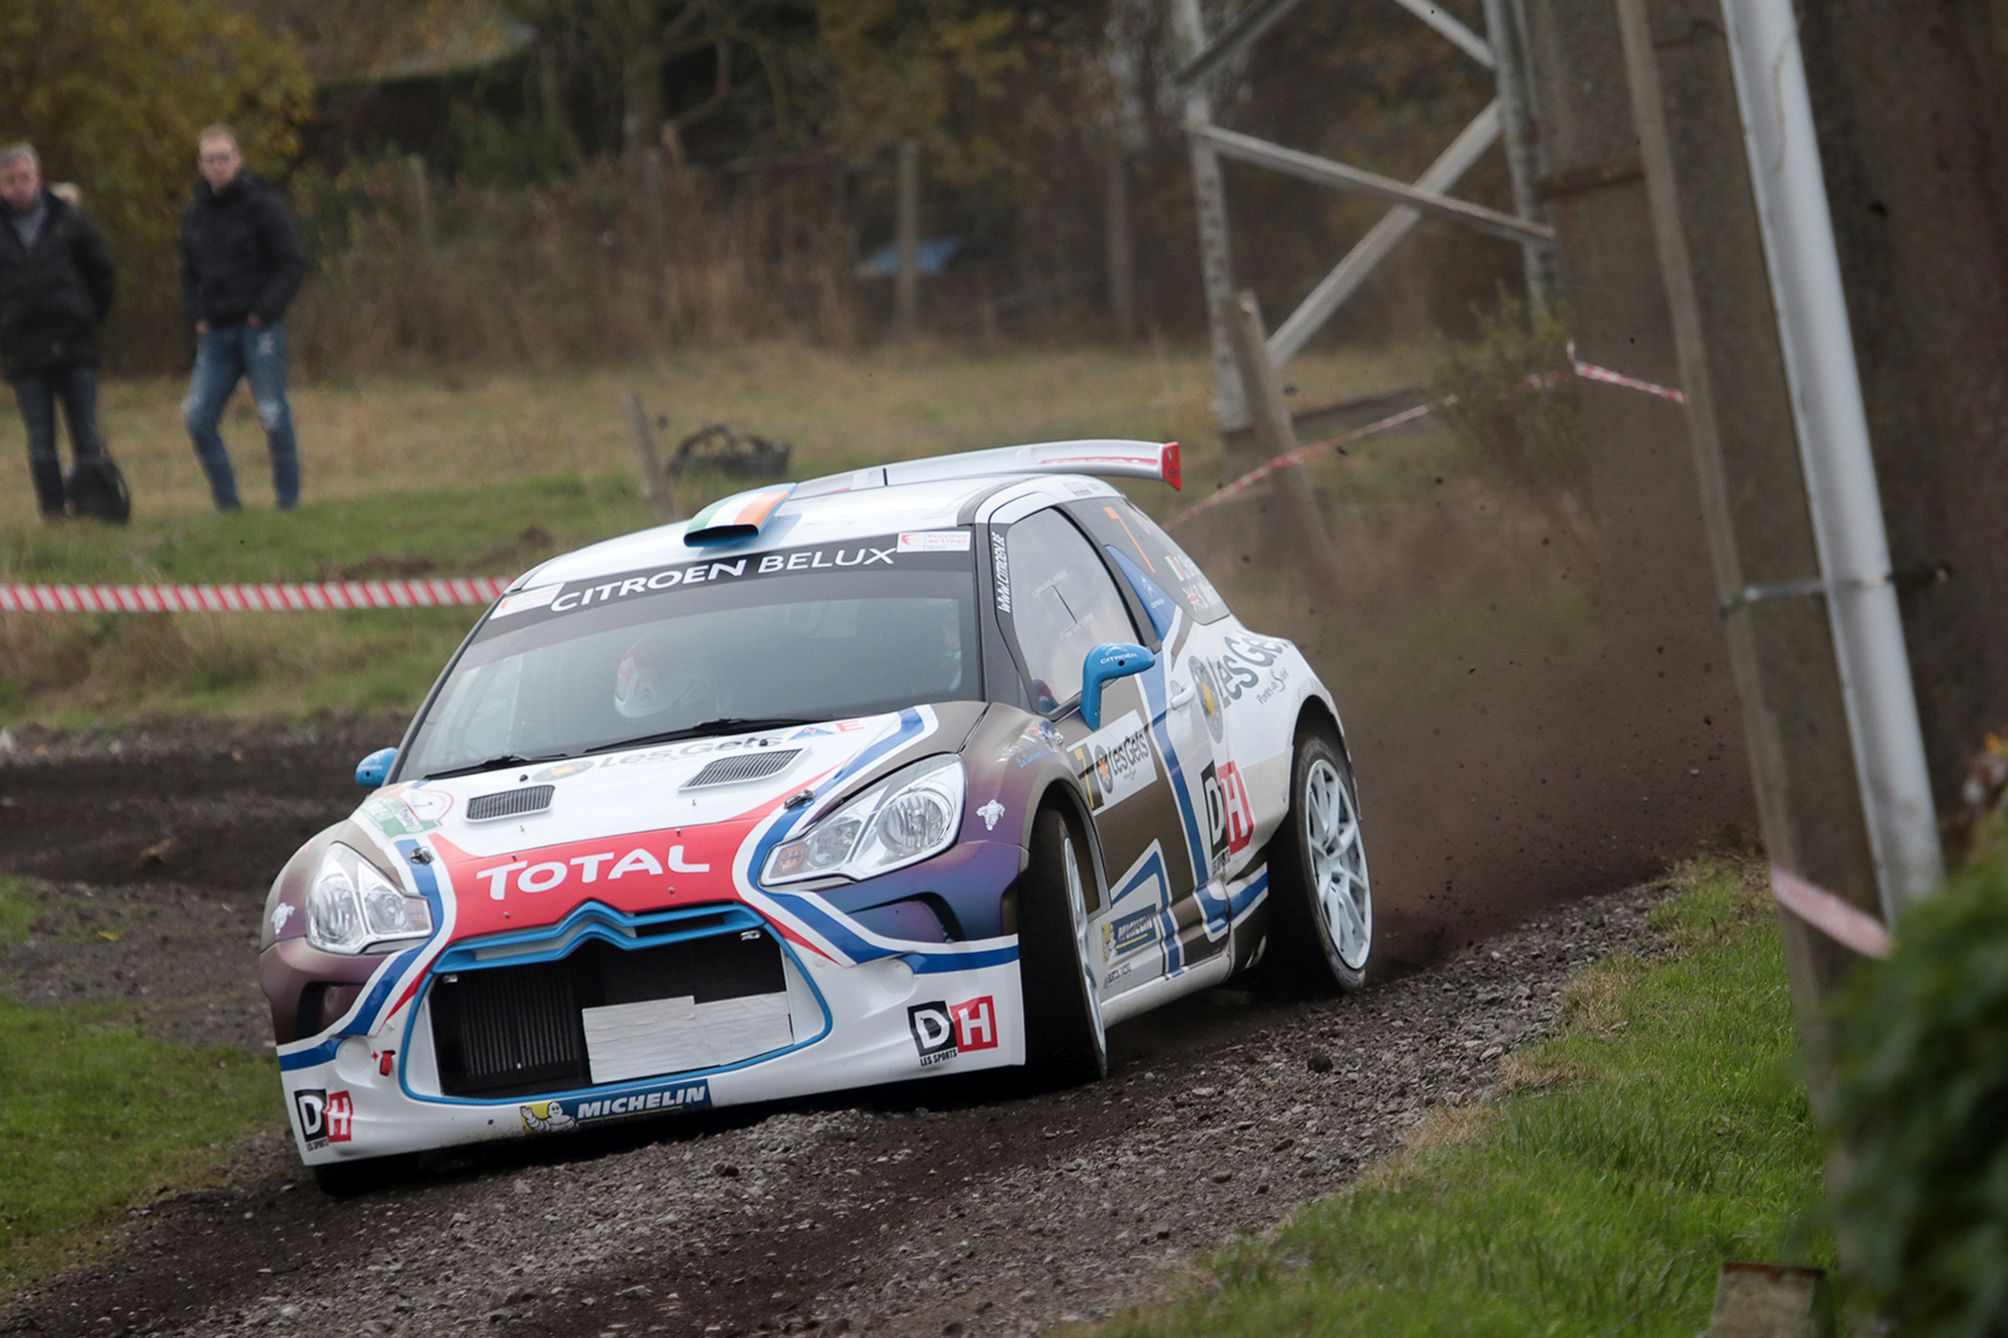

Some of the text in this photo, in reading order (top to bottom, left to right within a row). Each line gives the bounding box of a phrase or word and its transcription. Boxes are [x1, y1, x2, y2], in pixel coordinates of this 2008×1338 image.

[550, 560, 747, 612] CITROEN
[758, 548, 897, 574] BELUX
[475, 845, 710, 901] TOTAL
[577, 1085, 706, 1120] MICHELIN
